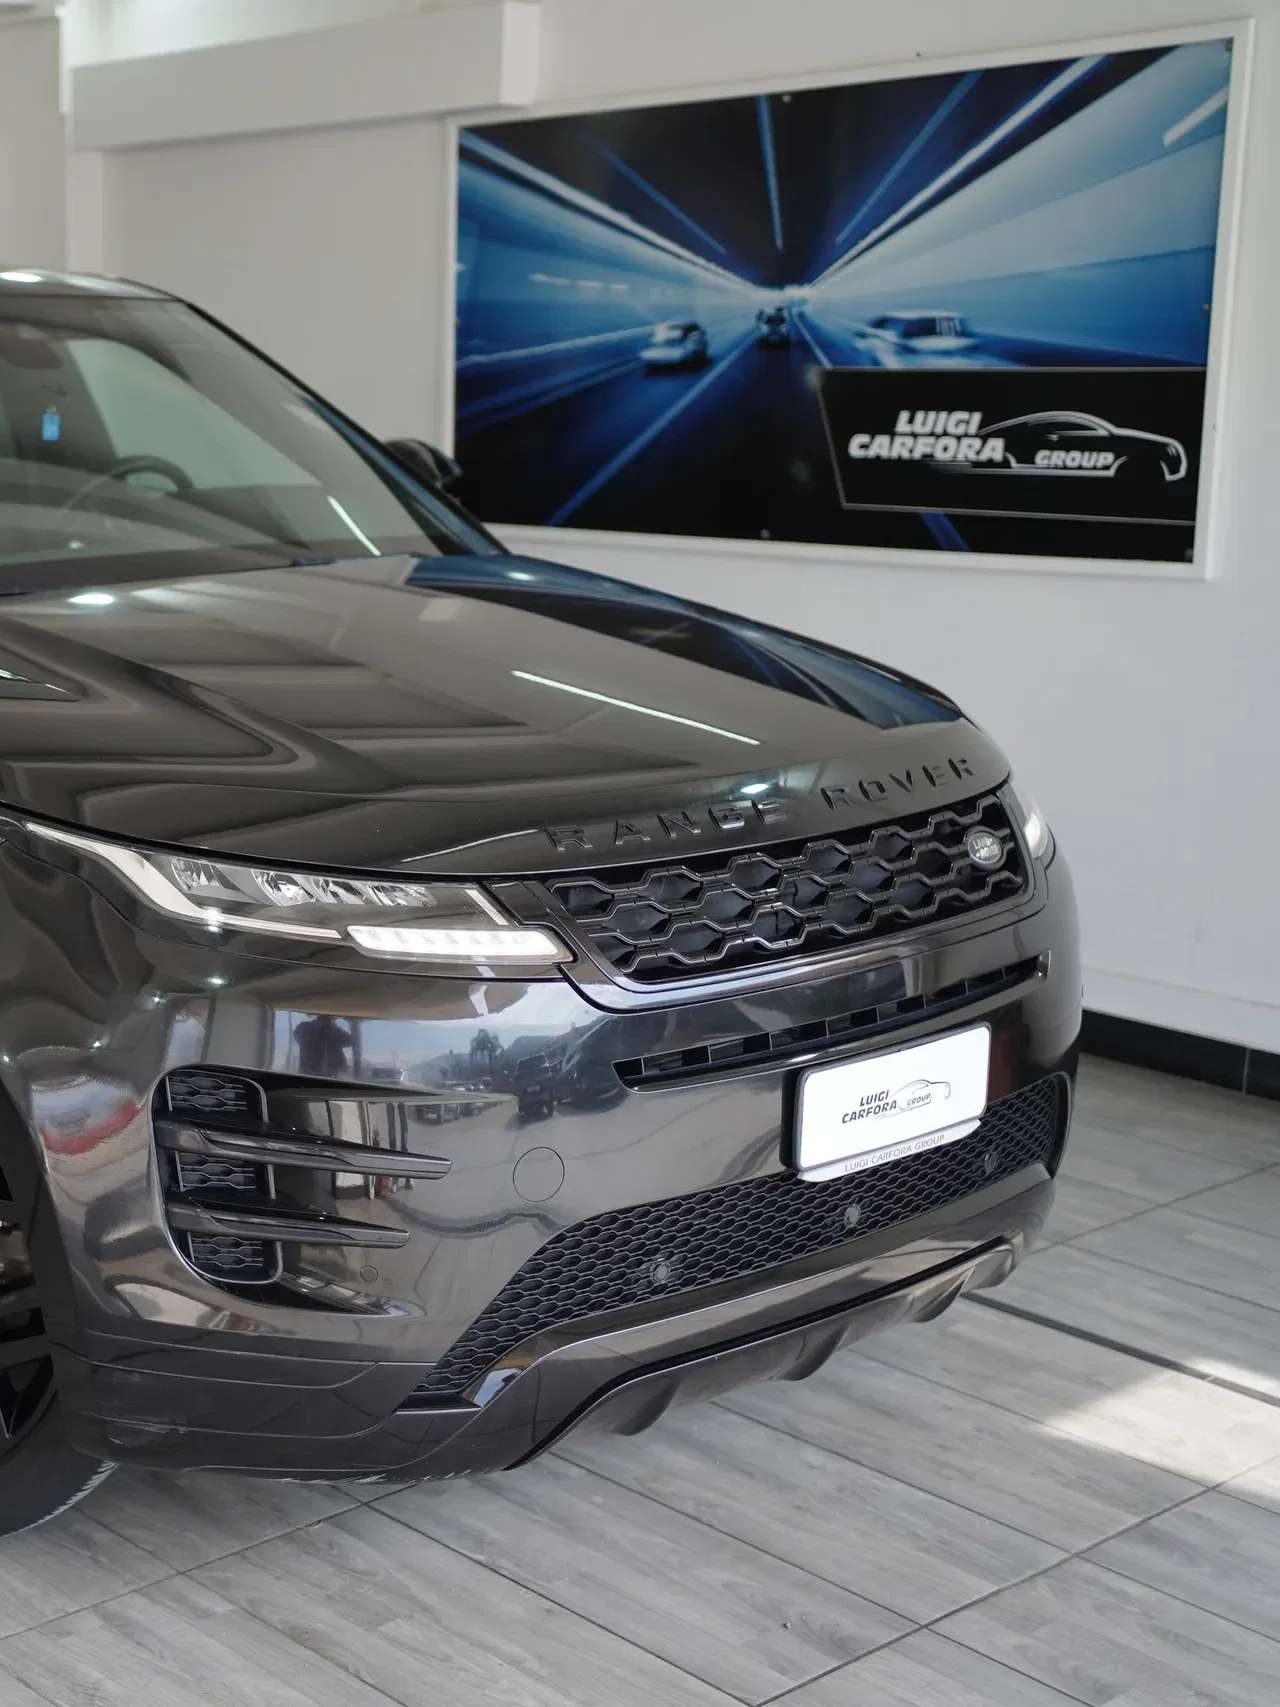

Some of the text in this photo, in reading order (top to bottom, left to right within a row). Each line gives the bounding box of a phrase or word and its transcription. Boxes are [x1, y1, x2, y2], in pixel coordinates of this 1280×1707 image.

[894, 410, 982, 436] LUIGI
[847, 434, 1115, 469] CARFORA GROUP
[543, 756, 977, 852] RANGE ROVER
[841, 1092, 932, 1124] CARFORA GROUP
[859, 1089, 890, 1107] LUIGI
[844, 1134, 945, 1173] LUIGI CARFORA GROUP
